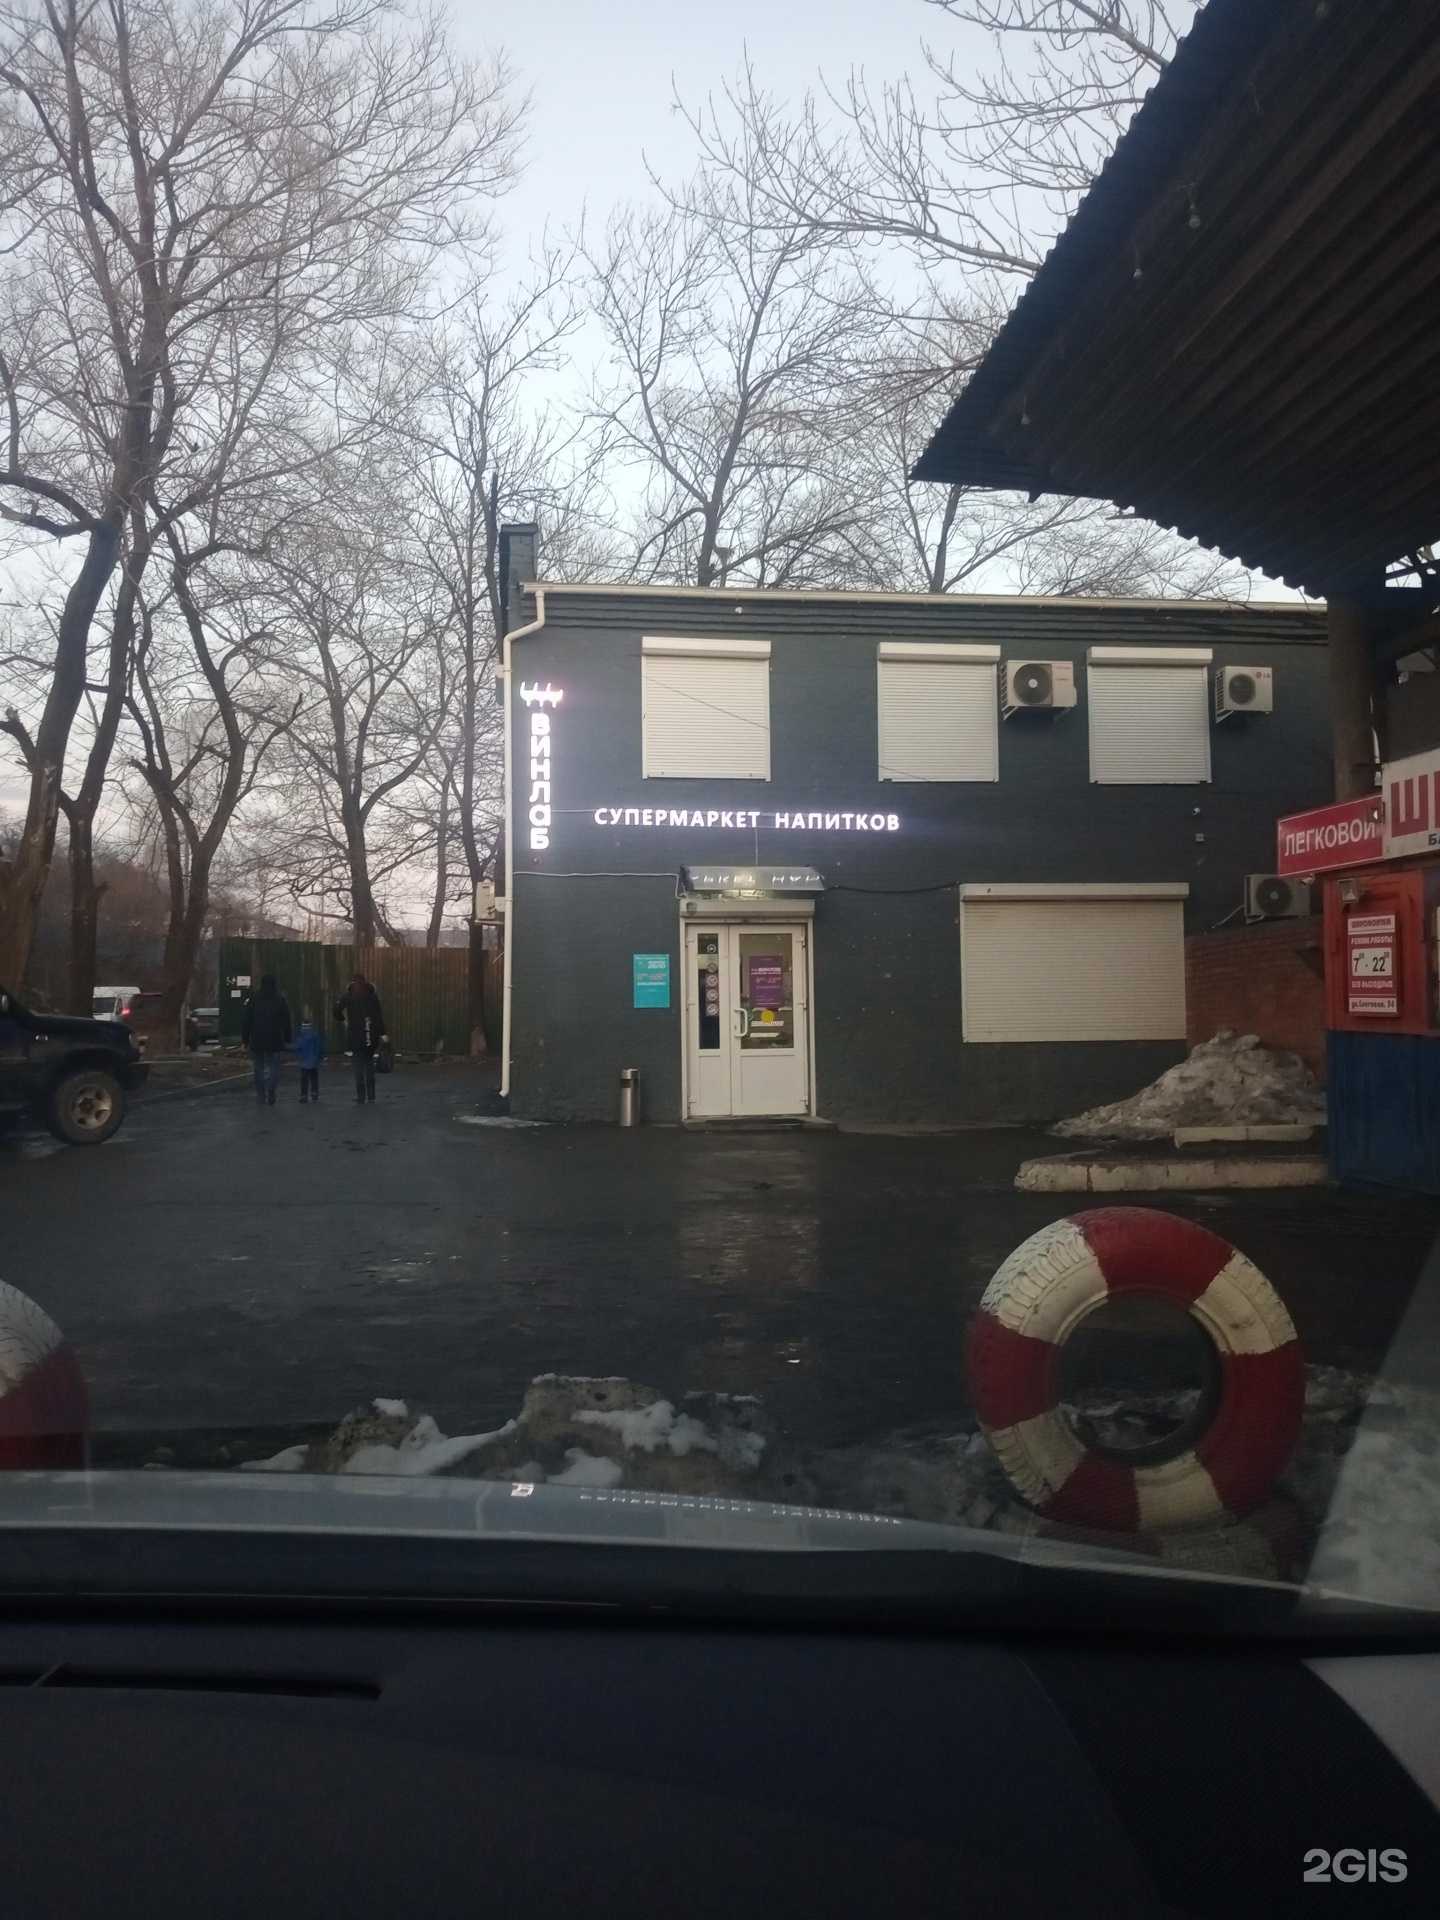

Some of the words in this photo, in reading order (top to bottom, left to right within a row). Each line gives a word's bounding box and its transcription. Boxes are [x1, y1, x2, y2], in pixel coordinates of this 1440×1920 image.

[594, 807, 761, 829] СУПЕРМАРКЕТ
[774, 811, 900, 831] НАПИТКОВ
[1391, 772, 1440, 838] Ш
